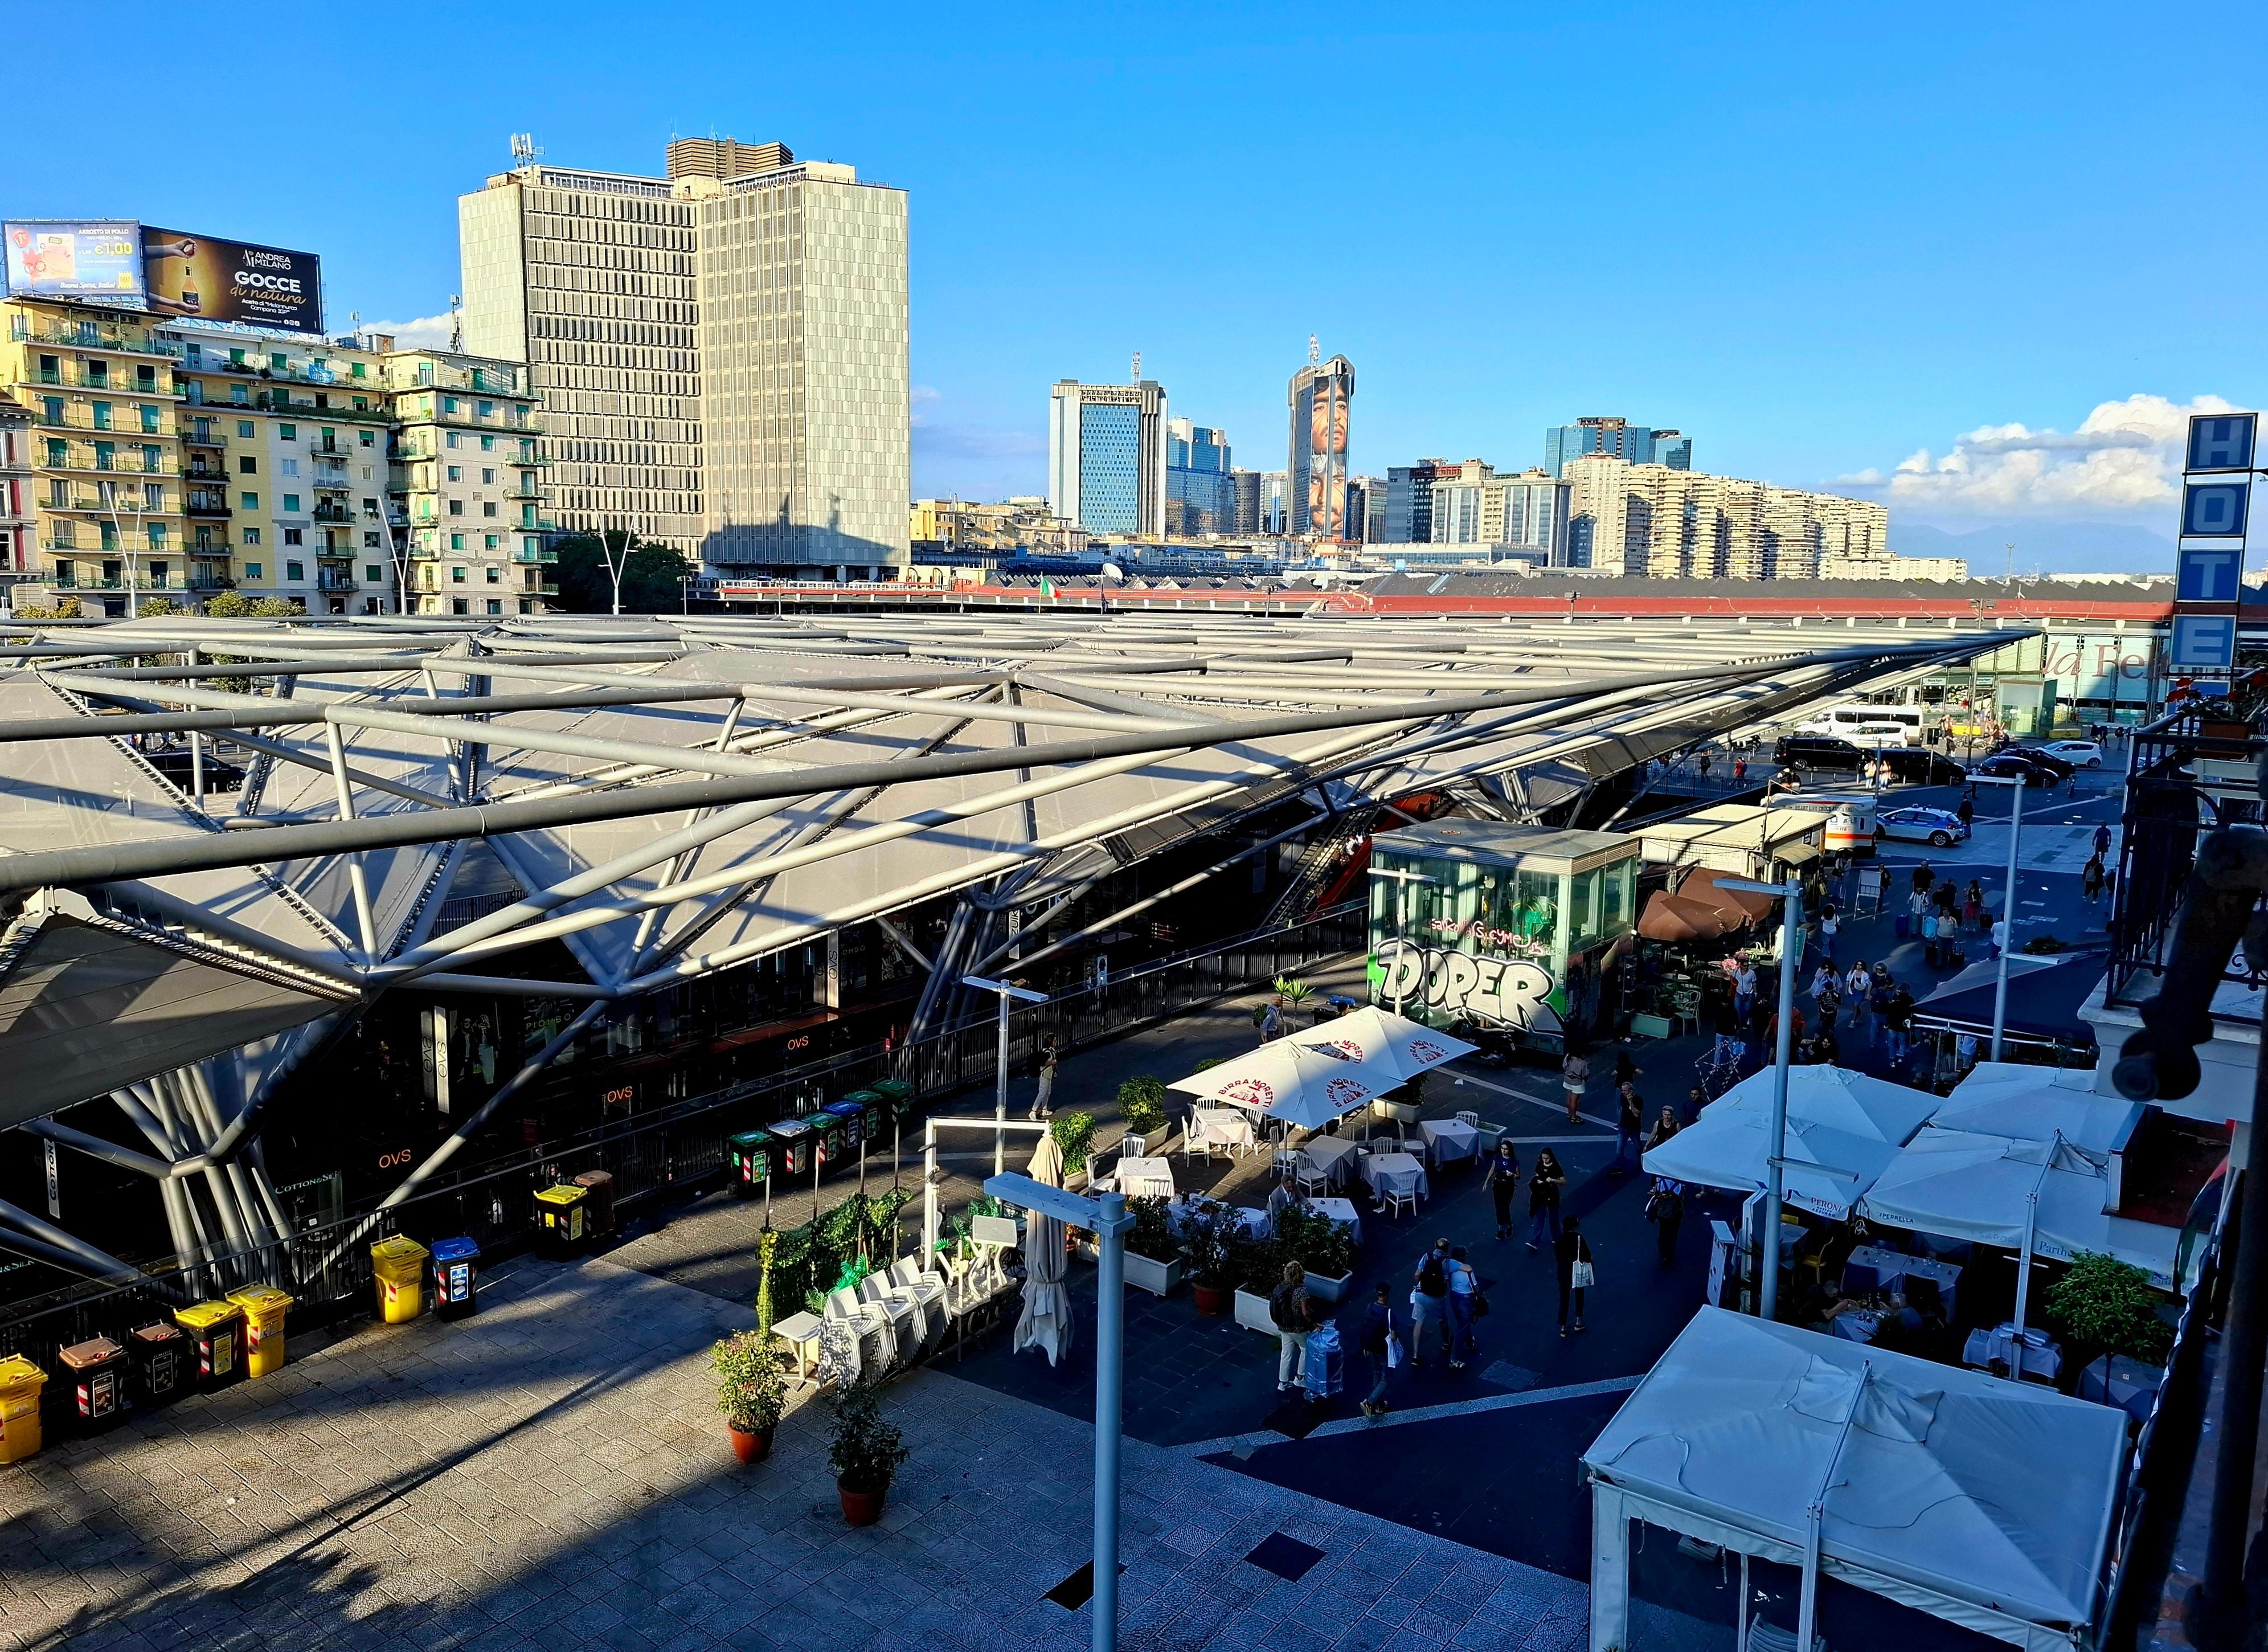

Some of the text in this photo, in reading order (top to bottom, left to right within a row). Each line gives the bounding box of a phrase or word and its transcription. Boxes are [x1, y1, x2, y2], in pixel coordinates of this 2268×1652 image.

[94, 242, 133, 257] €1,00
[255, 251, 291, 264] ANDREA
[255, 258, 292, 270] MILANO
[235, 271, 301, 293] GOCCE
[230, 283, 307, 305] di natura
[2043, 641, 2083, 676] la
[829, 950, 838, 979] OVS
[1377, 938, 1565, 1038] DOPER
[788, 1036, 808, 1050] OVS
[437, 1041, 447, 1078] OVS
[607, 1086, 632, 1102] OVS
[1218, 1079, 1274, 1108] BIRRA MORETTI
[1326, 1078, 1372, 1107] BIRRA MORETTI
[379, 1149, 411, 1168] OVS
[1811, 1197, 1842, 1212] PERONI
